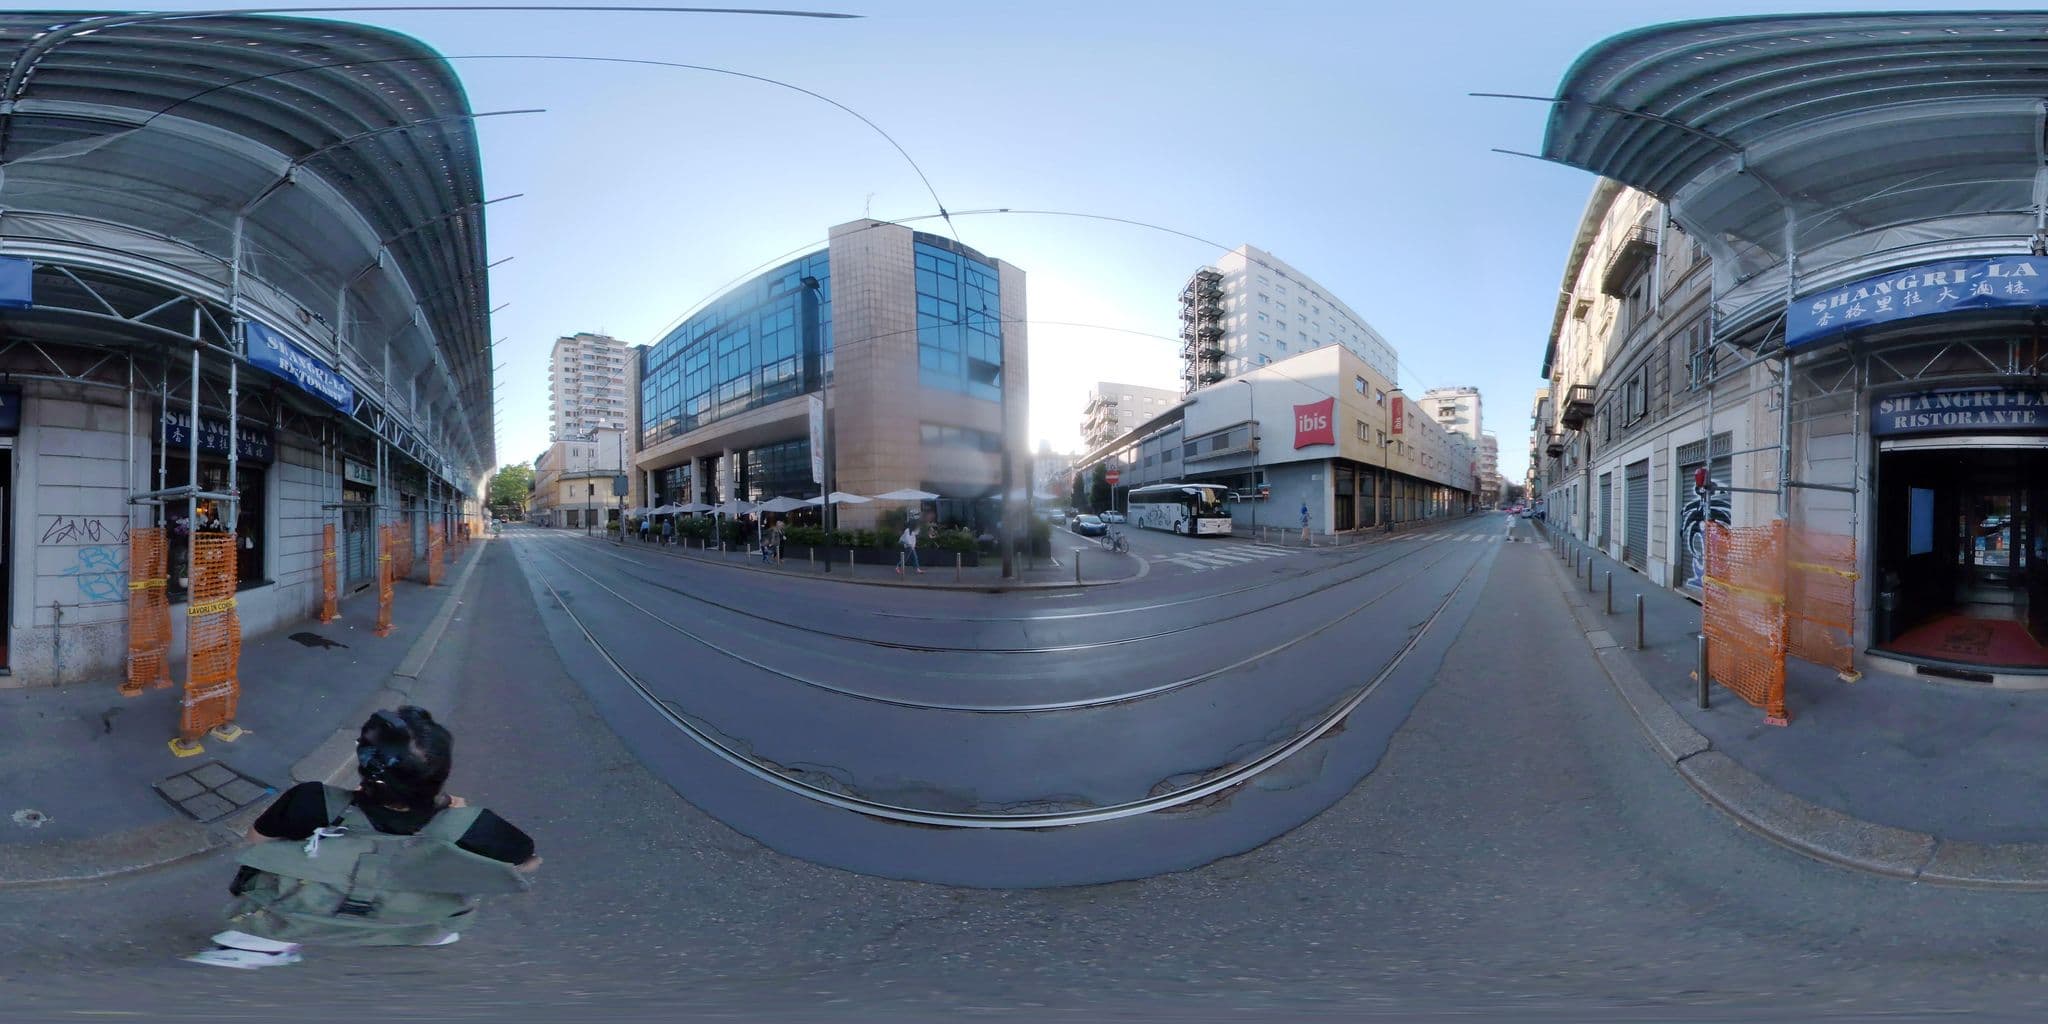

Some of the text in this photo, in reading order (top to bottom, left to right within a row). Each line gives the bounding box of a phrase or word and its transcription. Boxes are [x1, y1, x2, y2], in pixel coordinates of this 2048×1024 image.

[1812, 263, 2039, 315] SHANGRI-LA
[1300, 413, 1327, 432] ibis
[1894, 410, 2036, 428] RISTORANTE
[188, 606, 210, 615] LAVORI
[218, 601, 234, 611] CORS
